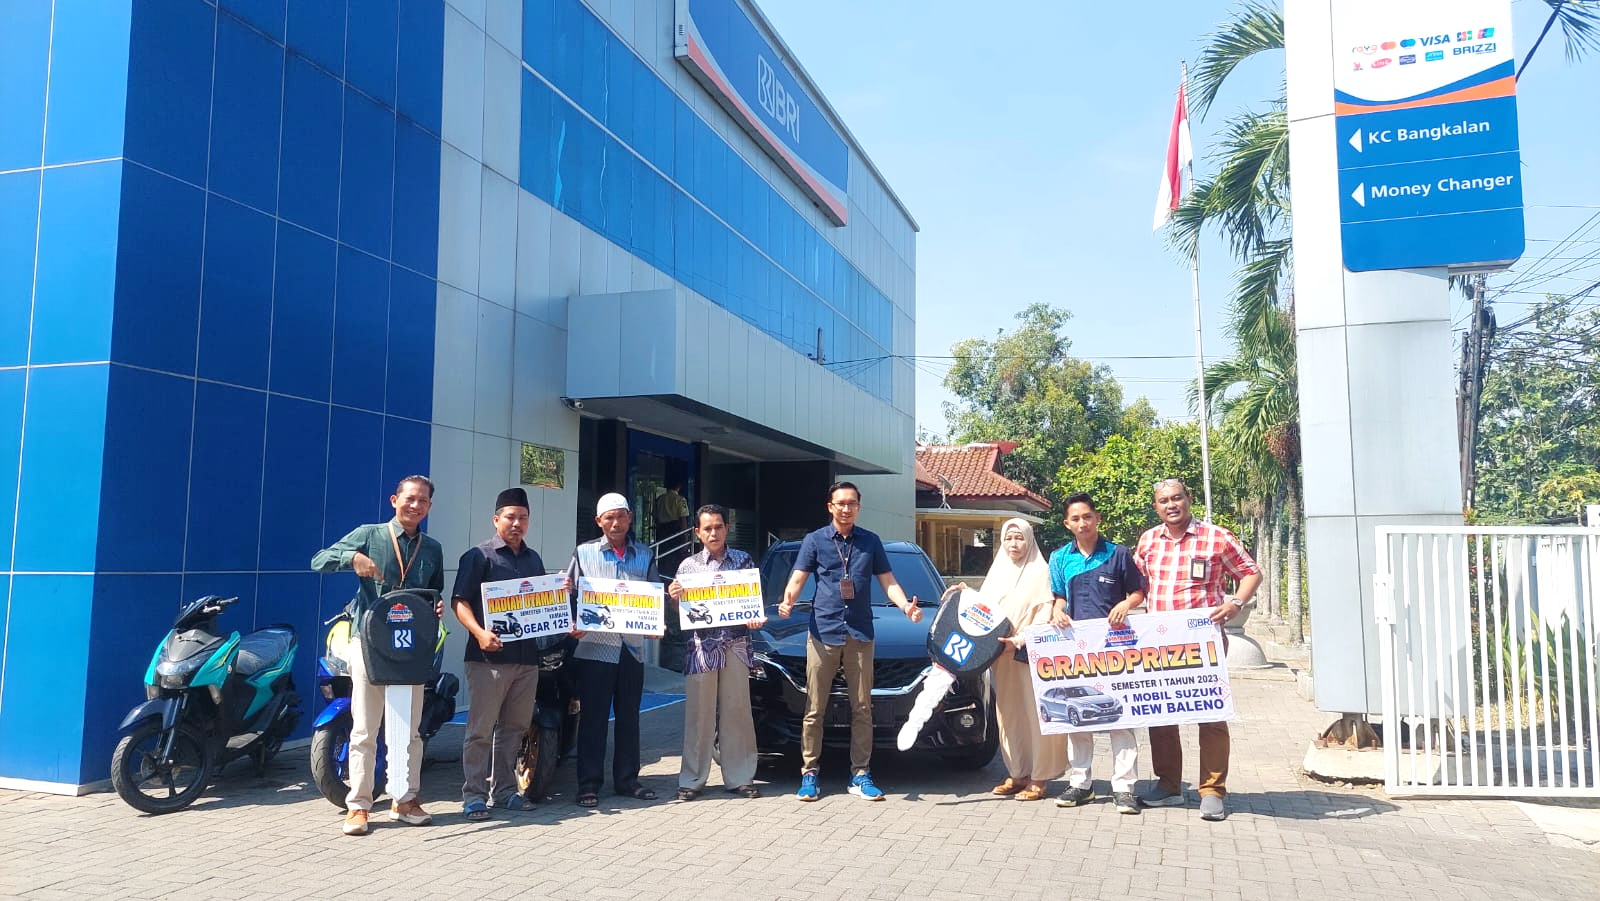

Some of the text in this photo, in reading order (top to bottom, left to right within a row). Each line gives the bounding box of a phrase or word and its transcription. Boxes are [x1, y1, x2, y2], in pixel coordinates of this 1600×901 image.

[1419, 34, 1451, 47] VISA
[1453, 43, 1497, 55] BRIZZI
[775, 78, 800, 144] BRI
[1368, 120, 1490, 144] KC Bangkalan
[1371, 175, 1513, 199] Money Changer
[719, 609, 760, 622] AEROX
[524, 619, 569, 634] GEAR 125
[626, 620, 658, 631] NMax
[1036, 643, 1203, 682] GRANDPRIZE
[1111, 680, 1157, 691] SEMESTER
[1164, 677, 1196, 687] TAHUN
[1198, 674, 1219, 684] 2023
[1122, 686, 1222, 703] 1 MOBIL SUZUKI
[1131, 698, 1224, 716] NEW BALENO
